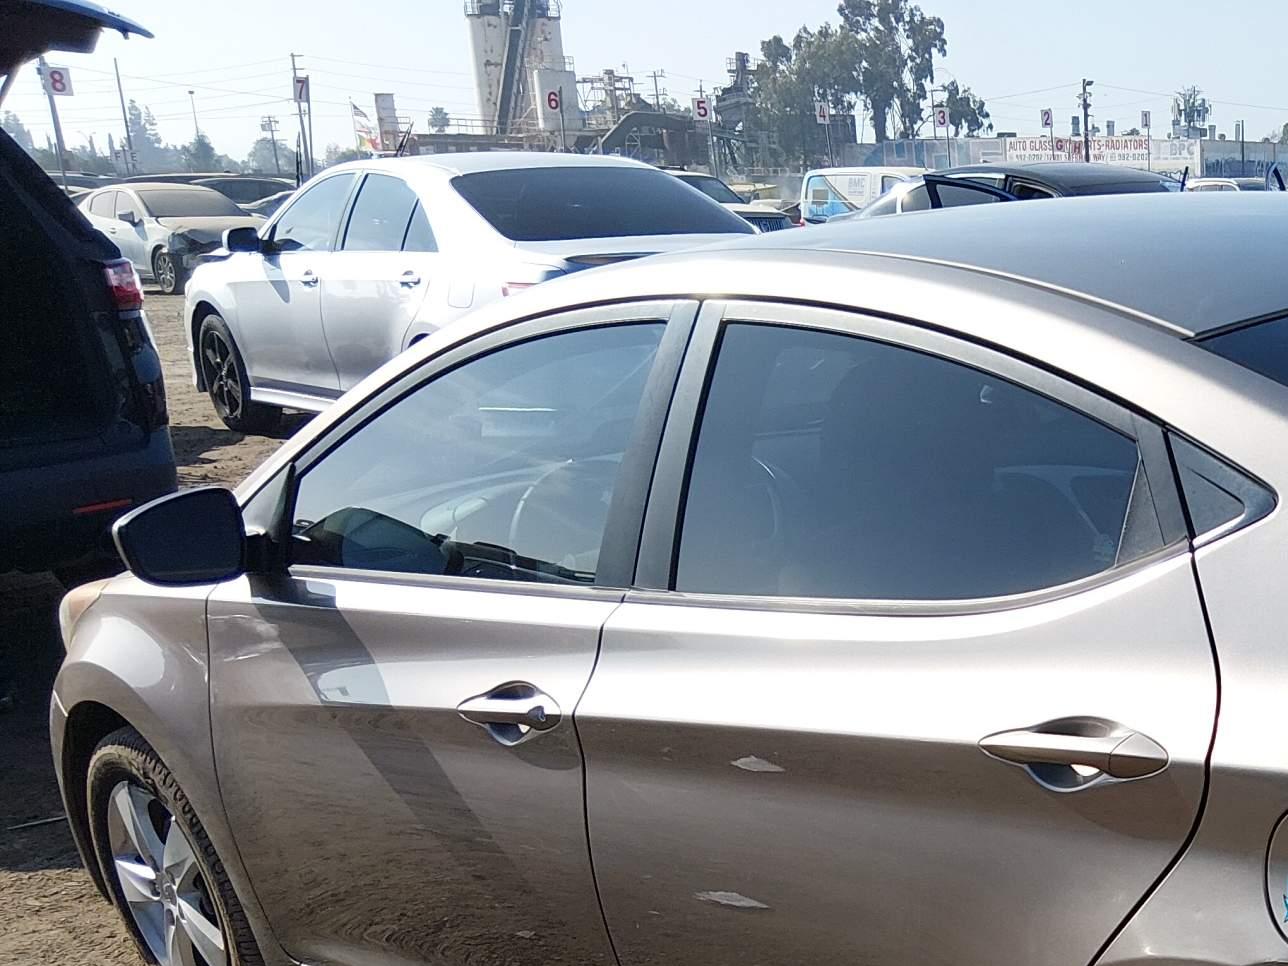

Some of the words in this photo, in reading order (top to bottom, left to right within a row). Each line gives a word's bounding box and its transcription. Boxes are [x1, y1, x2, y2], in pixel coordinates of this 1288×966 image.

[49, 70, 66, 92] 8
[295, 79, 305, 99] 7
[547, 91, 559, 110] 6
[696, 100, 708, 118] 5
[818, 105, 827, 122] 4
[937, 110, 946, 126] 3
[1043, 111, 1051, 126] 2
[1143, 113, 1149, 127] 1
[1008, 140, 1027, 152] AUTO
[1055, 139, 1063, 151] G
[1073, 142, 1081, 153] H
